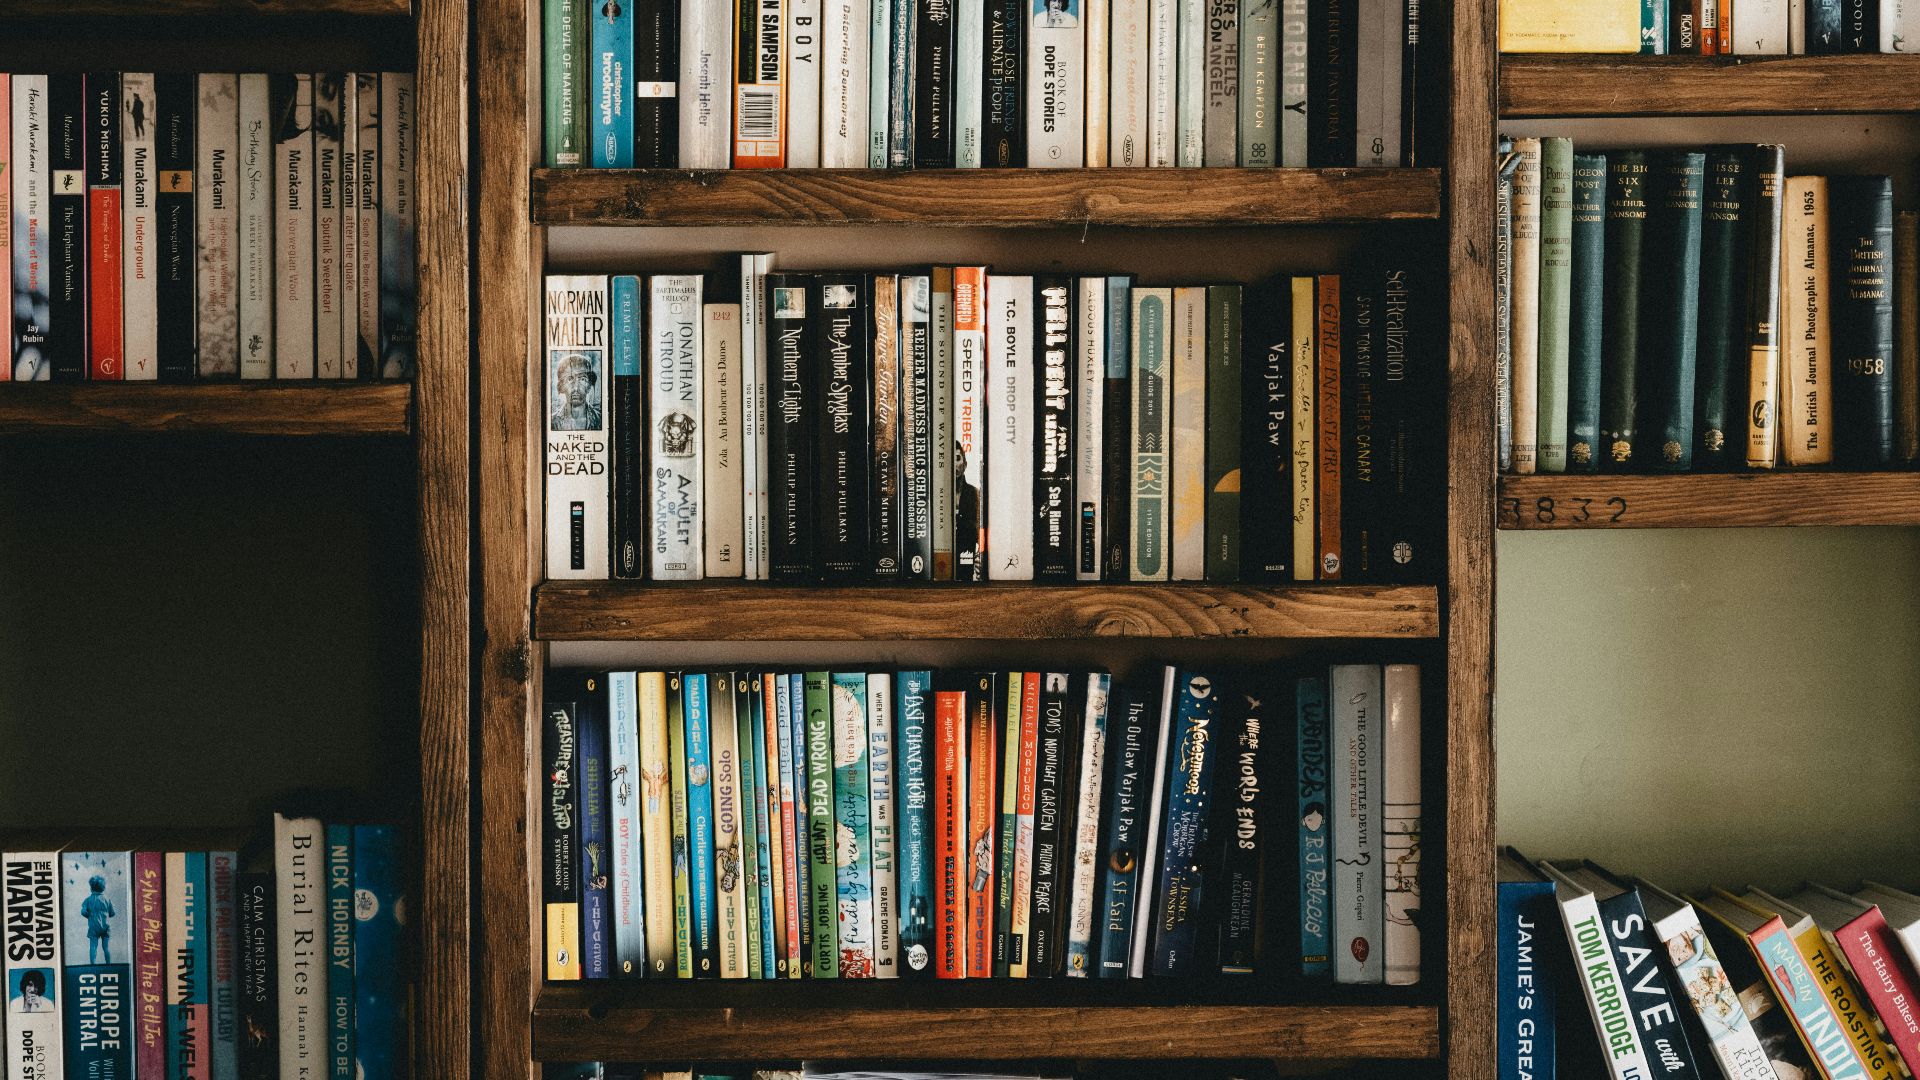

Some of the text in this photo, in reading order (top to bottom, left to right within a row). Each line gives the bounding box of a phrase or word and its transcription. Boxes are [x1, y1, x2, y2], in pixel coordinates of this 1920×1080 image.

[563, 54, 571, 69] OF
[762, 15, 778, 80] SAMPSON
[796, 17, 812, 63] BOY
[1681, 14, 1691, 48] PICADOR
[563, 72, 571, 124] NANKING
[601, 52, 613, 124] brookmyre
[614, 62, 622, 116] christopher
[932, 47, 942, 138] PHILIP PULLMAN
[1044, 46, 1055, 132] DOPE STORIES
[1057, 62, 1066, 118] BOOK OF
[1256, 36, 1265, 128] BETH KEMPTON
[27, 88, 39, 173] Haruki Murakami
[100, 90, 110, 180] YUKIO MISHIMA
[101, 209, 110, 231] Temple
[134, 147, 148, 279] Murakami Underground
[321, 149, 335, 314] Murakami Sputnik Sweetheart
[344, 153, 356, 291] Murakami after the quake
[1804, 224, 1815, 269] Almanac,
[63, 205, 74, 301] The Elephant Vanishes
[548, 290, 603, 314] NORMAN
[548, 317, 603, 346] MAILER
[1803, 277, 1817, 340] Photographic
[660, 331, 674, 392] STROUD
[678, 321, 693, 401] JONATHAN
[779, 326, 802, 423] Northern Lights
[828, 315, 852, 433] The Amber Spyglass
[962, 339, 972, 452] SPEED TRIBES
[1006, 299, 1016, 444] T.C. BOYLE DROP CITY
[1265, 343, 1284, 445] Varjak Paw
[1805, 348, 1817, 384] Journal
[1848, 358, 1884, 375] 1958
[915, 329, 926, 539] REEFER MADNESS ERIC SCHLOSSER
[938, 397, 945, 415] OF
[1805, 392, 1817, 426] British
[1806, 432, 1818, 450] The
[548, 462, 605, 475] DEAD
[549, 442, 604, 452] NAKED
[657, 467, 671, 553] SAMARKAND
[668, 502, 676, 515] OF
[677, 474, 692, 545] AMULET
[787, 454, 796, 544] PHILIP PULLMAN
[811, 721, 827, 816] DEAD WRONG
[872, 733, 890, 800] EARTH
[1040, 701, 1062, 831] TOM'S MIDNIGHT GARDEN
[1118, 703, 1143, 842] The Outlaw Varjak Paw
[1358, 708, 1366, 847] THE GOOD LITTLE DEVIL
[620, 819, 629, 839] BOY
[878, 805, 886, 819] WAS
[34, 861, 51, 870] THE
[555, 838, 563, 886] STEVENSON
[620, 842, 629, 866] Tales
[875, 826, 891, 872] FLAT
[1035, 843, 1053, 913] PHILIPPA PEARCE
[7, 862, 34, 962] MARKS
[35, 870, 54, 961] HOWARD
[243, 922, 251, 949] HAPPY
[293, 834, 314, 995] Burial Rites
[331, 845, 352, 969] NICK HORNBY
[622, 879, 630, 925] Childhood
[818, 884, 830, 971] CURTIS JOBLING
[880, 886, 889, 950] GRAEME DONALD
[140, 870, 162, 1047] Sylvia Plath The Bell Jar
[254, 886, 267, 1002] CALM CHRISTMAS
[1518, 914, 1533, 1010] JAMIE'S
[1611, 913, 1675, 1032] SAVE
[1773, 940, 1812, 1002] MADE IN
[1860, 931, 1879, 962] The
[1872, 953, 1896, 994] Hairy
[79, 974, 98, 1051] CENTRAL
[100, 974, 120, 1050] EUROPE
[1573, 916, 1635, 1060] TOM KERRIDGE
[1812, 949, 1884, 1071] THE ROASTING
